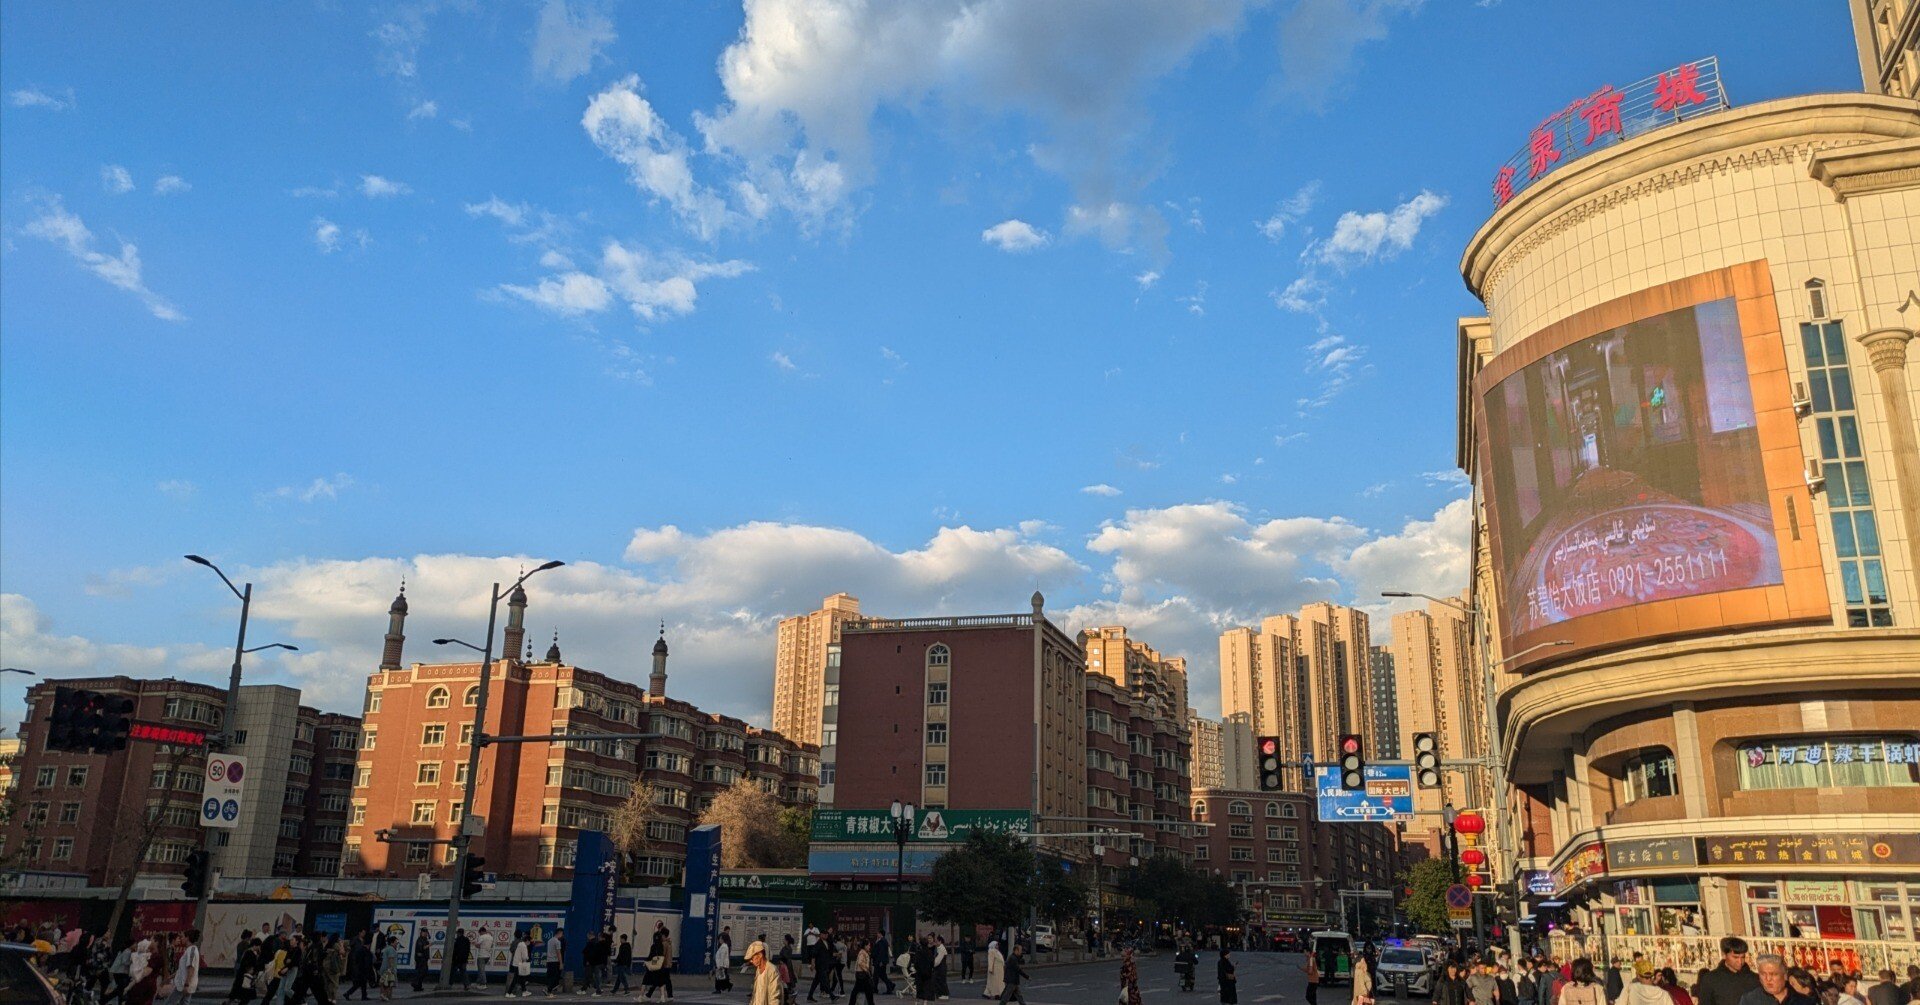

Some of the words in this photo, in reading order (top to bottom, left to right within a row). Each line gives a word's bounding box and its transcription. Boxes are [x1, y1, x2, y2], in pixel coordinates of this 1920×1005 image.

[1494, 62, 1707, 208] 金泉商城
[1526, 568, 1602, 621] 苏碧怡大饭店
[1608, 548, 1727, 596] 0991-2551111
[212, 766, 223, 776] 50
[1320, 788, 1342, 797] 人民路
[1369, 787, 1409, 795] 国际大巴扎
[718, 877, 745, 888] 色美食
[421, 919, 460, 927] 施工重
